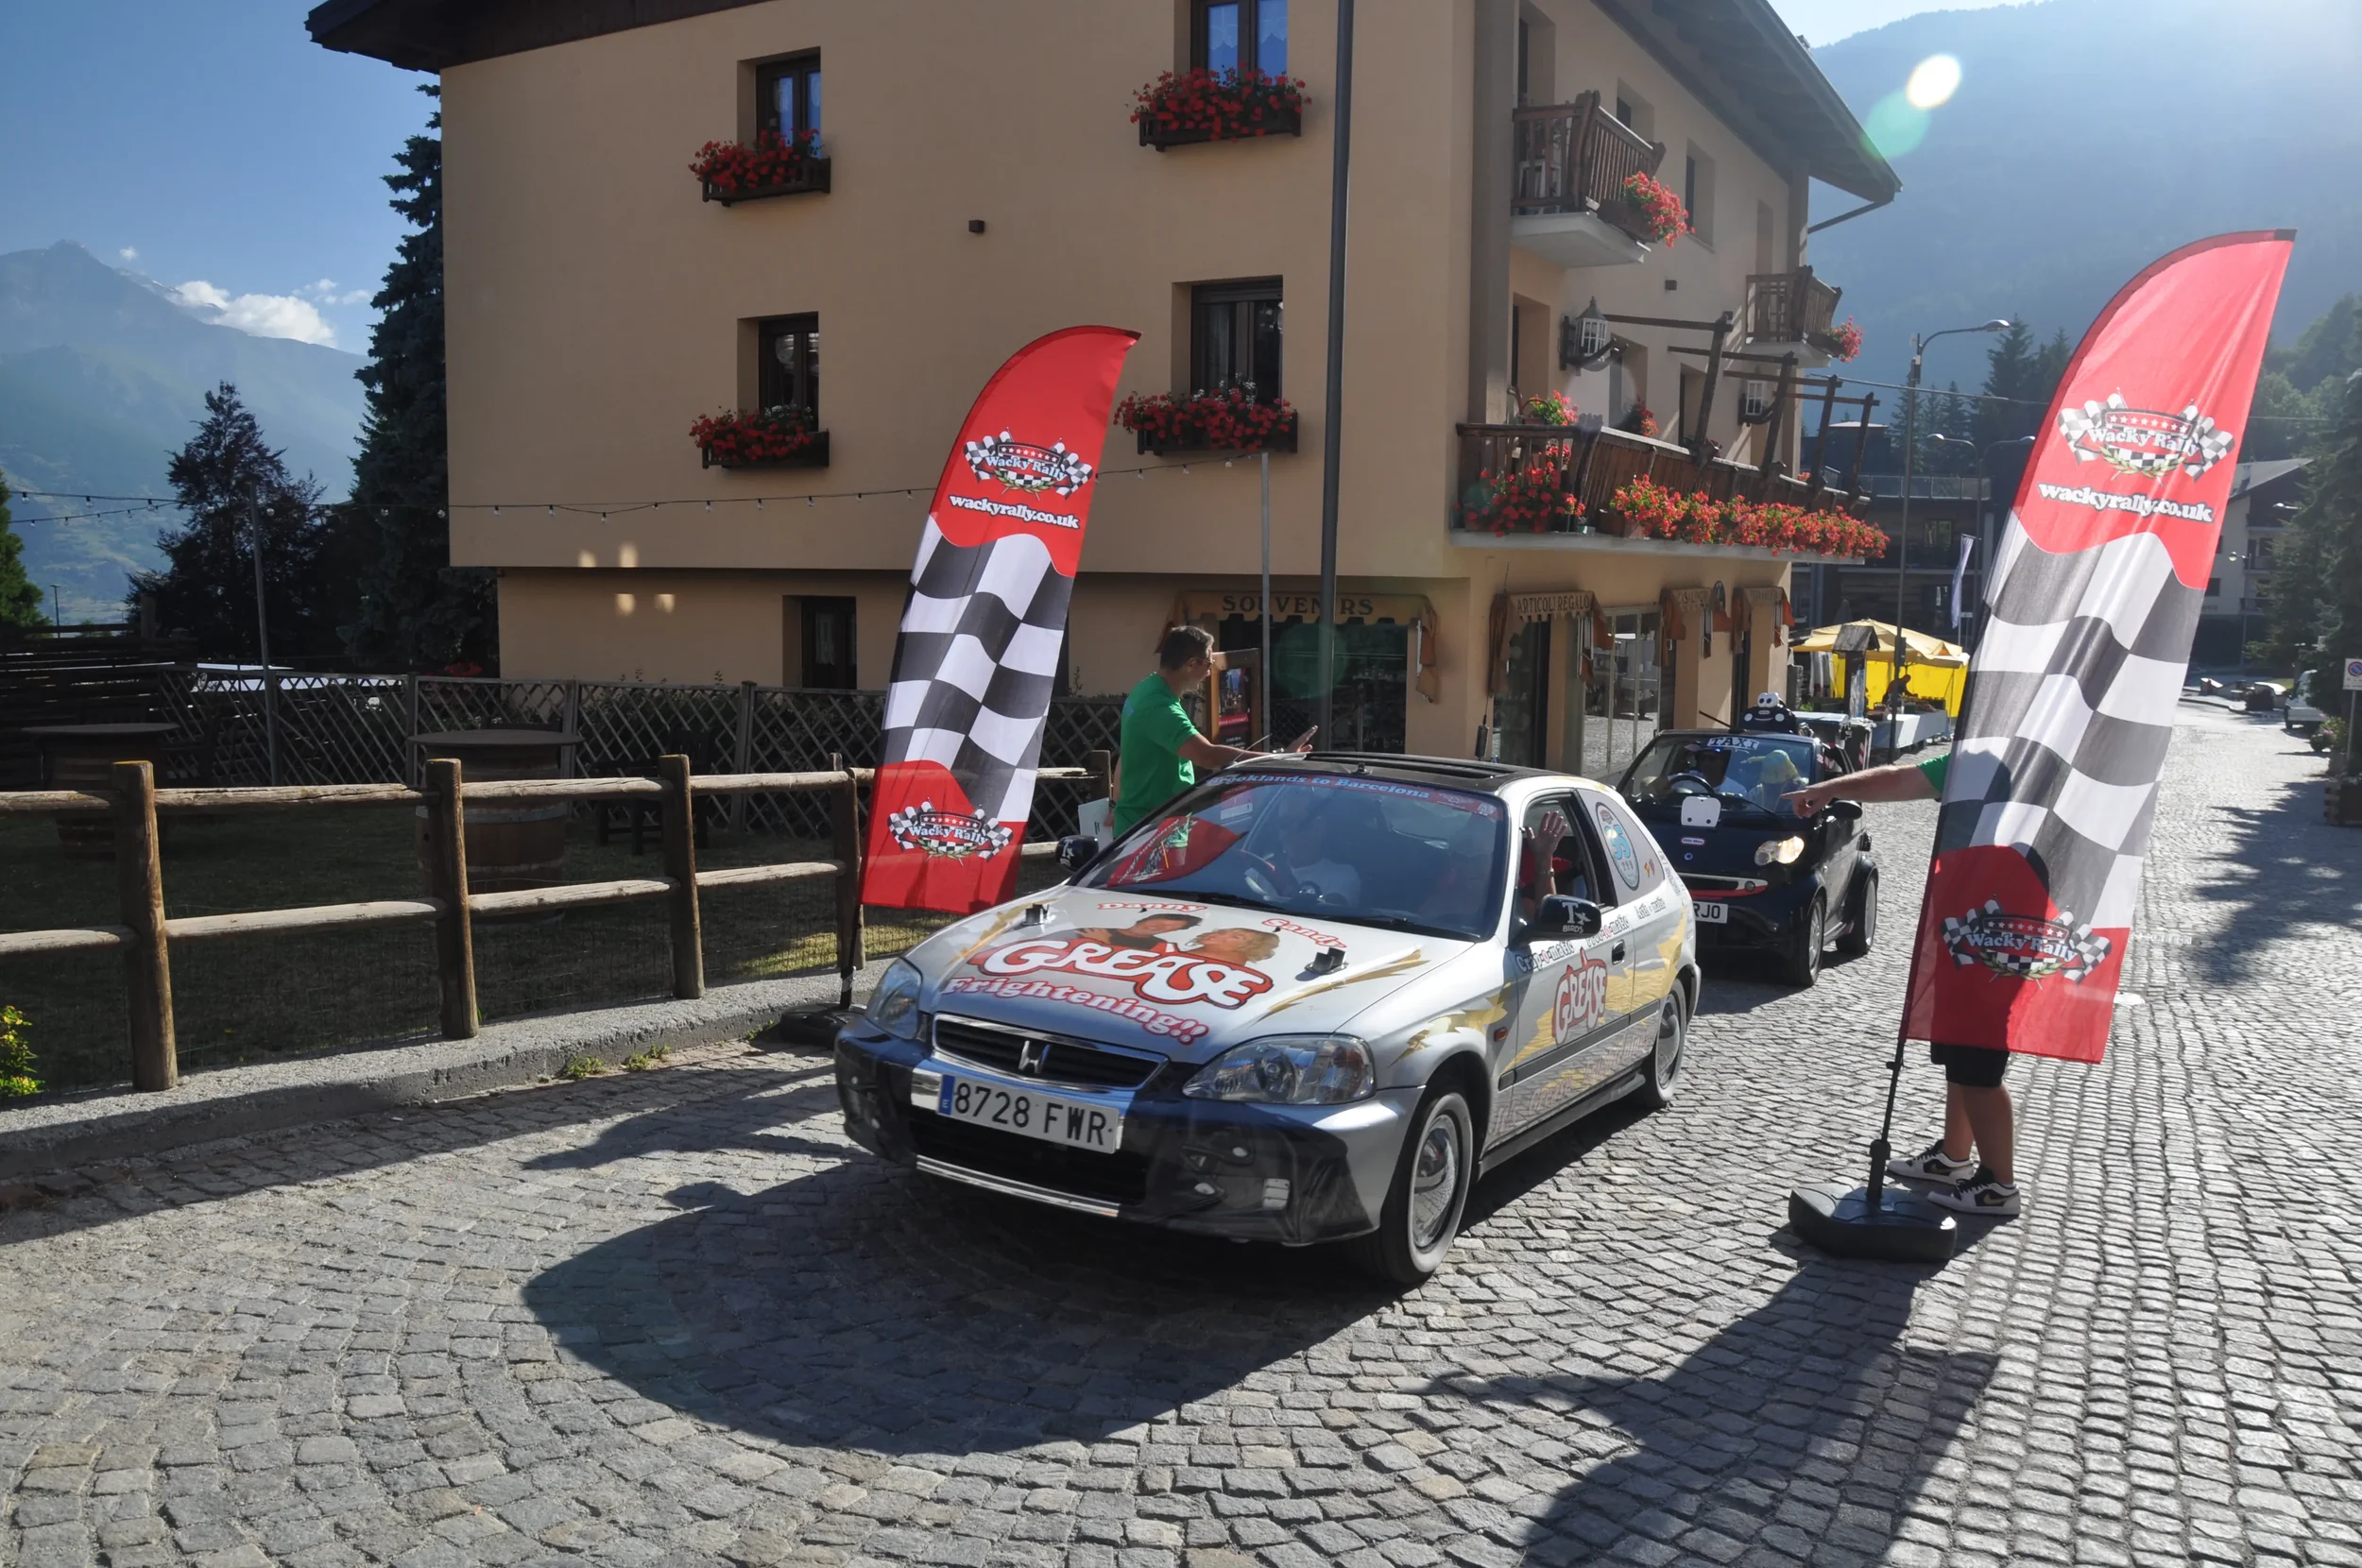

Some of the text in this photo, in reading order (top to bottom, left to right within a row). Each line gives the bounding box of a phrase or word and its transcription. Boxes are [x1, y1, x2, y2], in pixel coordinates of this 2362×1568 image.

[2089, 428, 2199, 456] Wacky Rally
[984, 455, 1068, 481] Wacky Rally
[949, 495, 1080, 529] wackyrally.co.uk
[2038, 483, 2215, 523] wackyrally.co.uk
[1222, 595, 1374, 615] SOVENRS
[1517, 594, 1590, 613] ARTICOLI REGALO
[1709, 737, 1757, 749] TAXI
[1311, 776, 1330, 786] to
[1334, 777, 1430, 799] Barcelona
[908, 825, 988, 845] Wacky Rally
[1098, 901, 1209, 913] Danny
[1562, 901, 1579, 924] T
[1261, 917, 1347, 949] Sandy
[1562, 925, 1583, 933] BIRDS
[1965, 931, 2078, 962] Wacky Rally
[983, 941, 1268, 1007] GREASE
[941, 976, 1209, 1047] Frightening!!
[1554, 964, 1606, 1045] GREASE
[954, 1082, 1107, 1146] 8728 FWR
